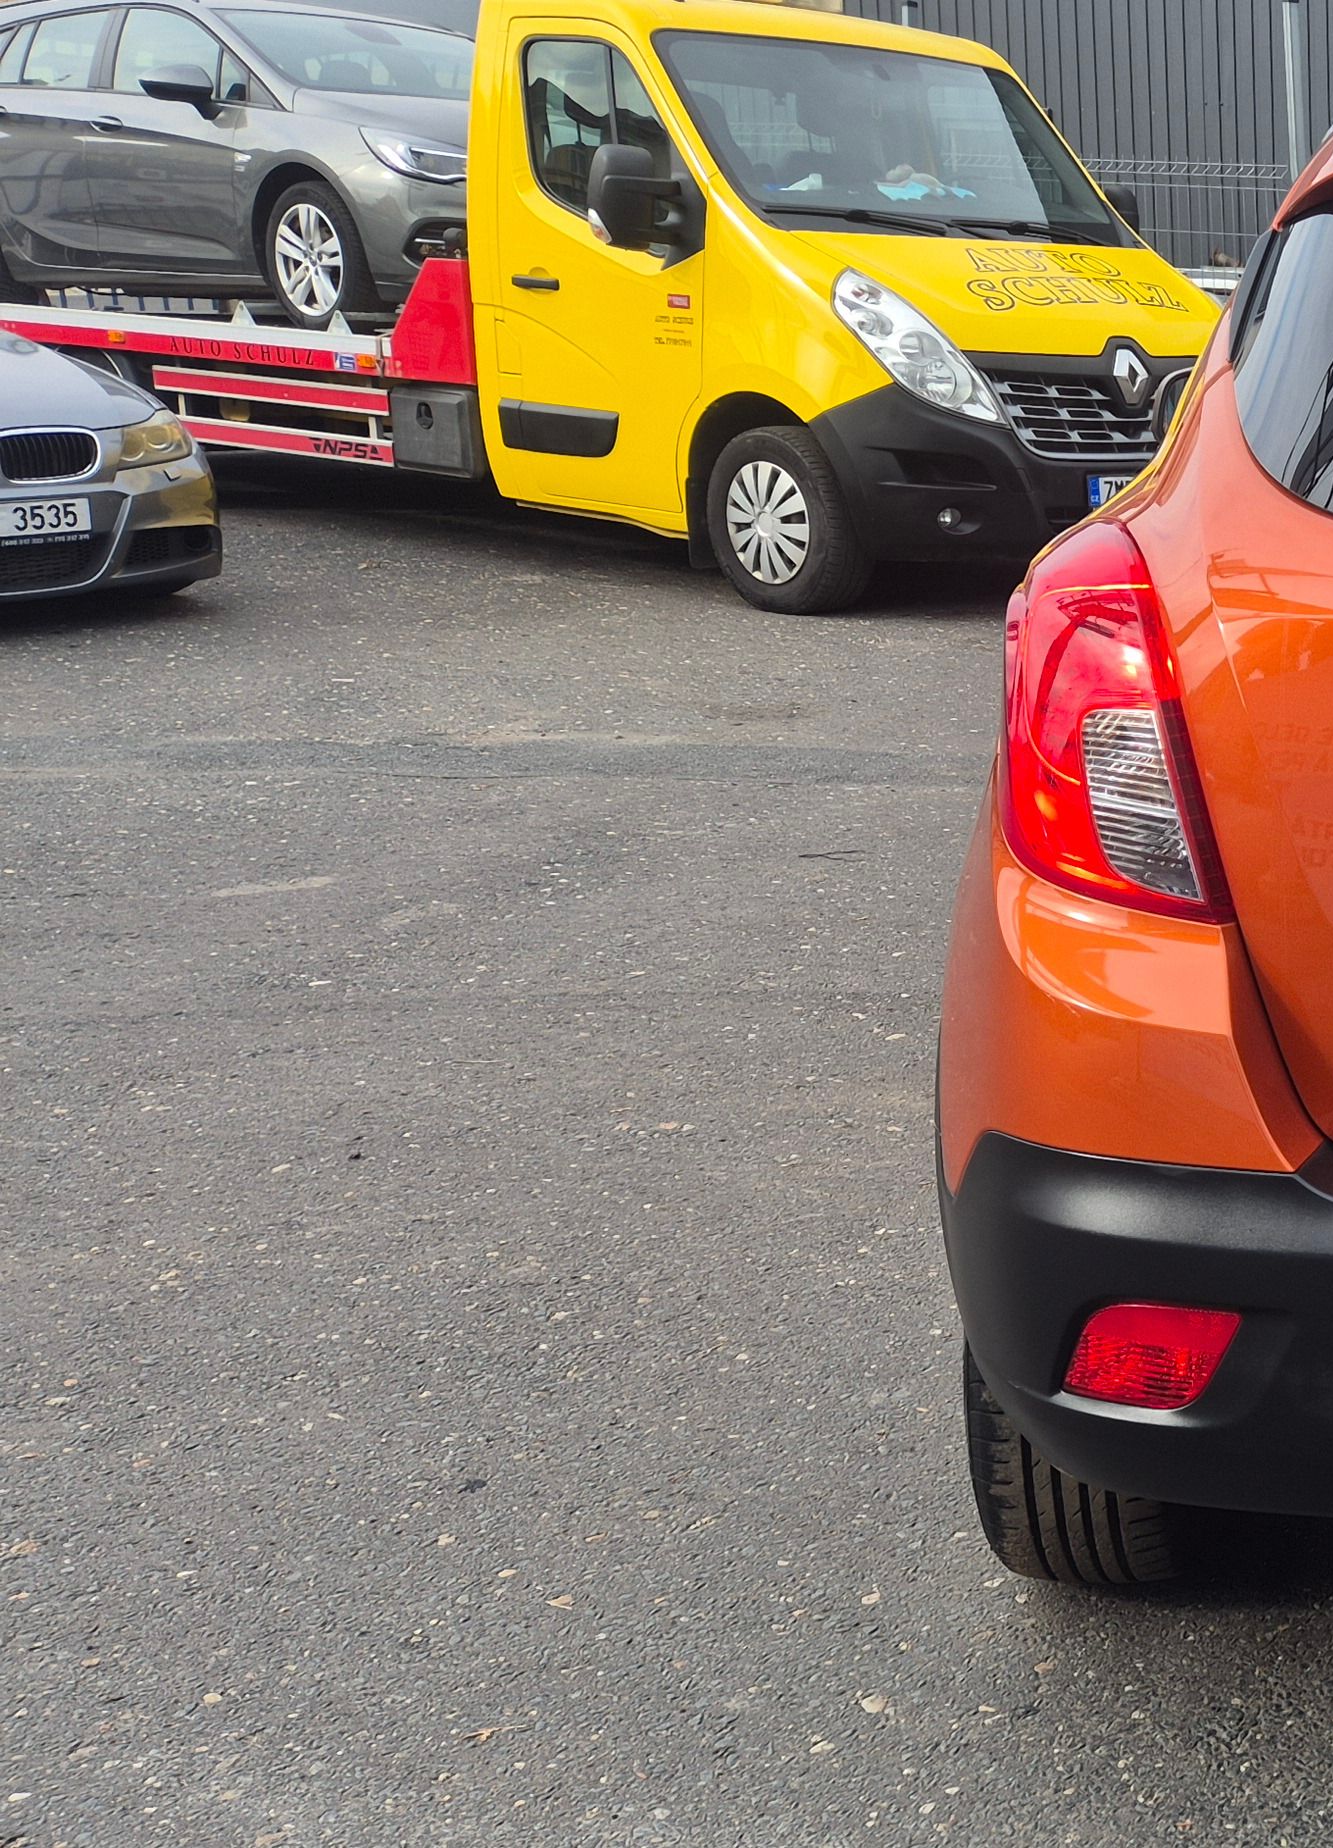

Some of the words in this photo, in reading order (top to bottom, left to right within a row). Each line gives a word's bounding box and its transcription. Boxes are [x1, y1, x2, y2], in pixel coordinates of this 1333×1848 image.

[965, 248, 1121, 276] AUTO
[966, 276, 1190, 312] SCHULZ
[170, 336, 221, 356] AUTO
[234, 344, 314, 366] SCHULZ
[12, 502, 79, 532] 3535
